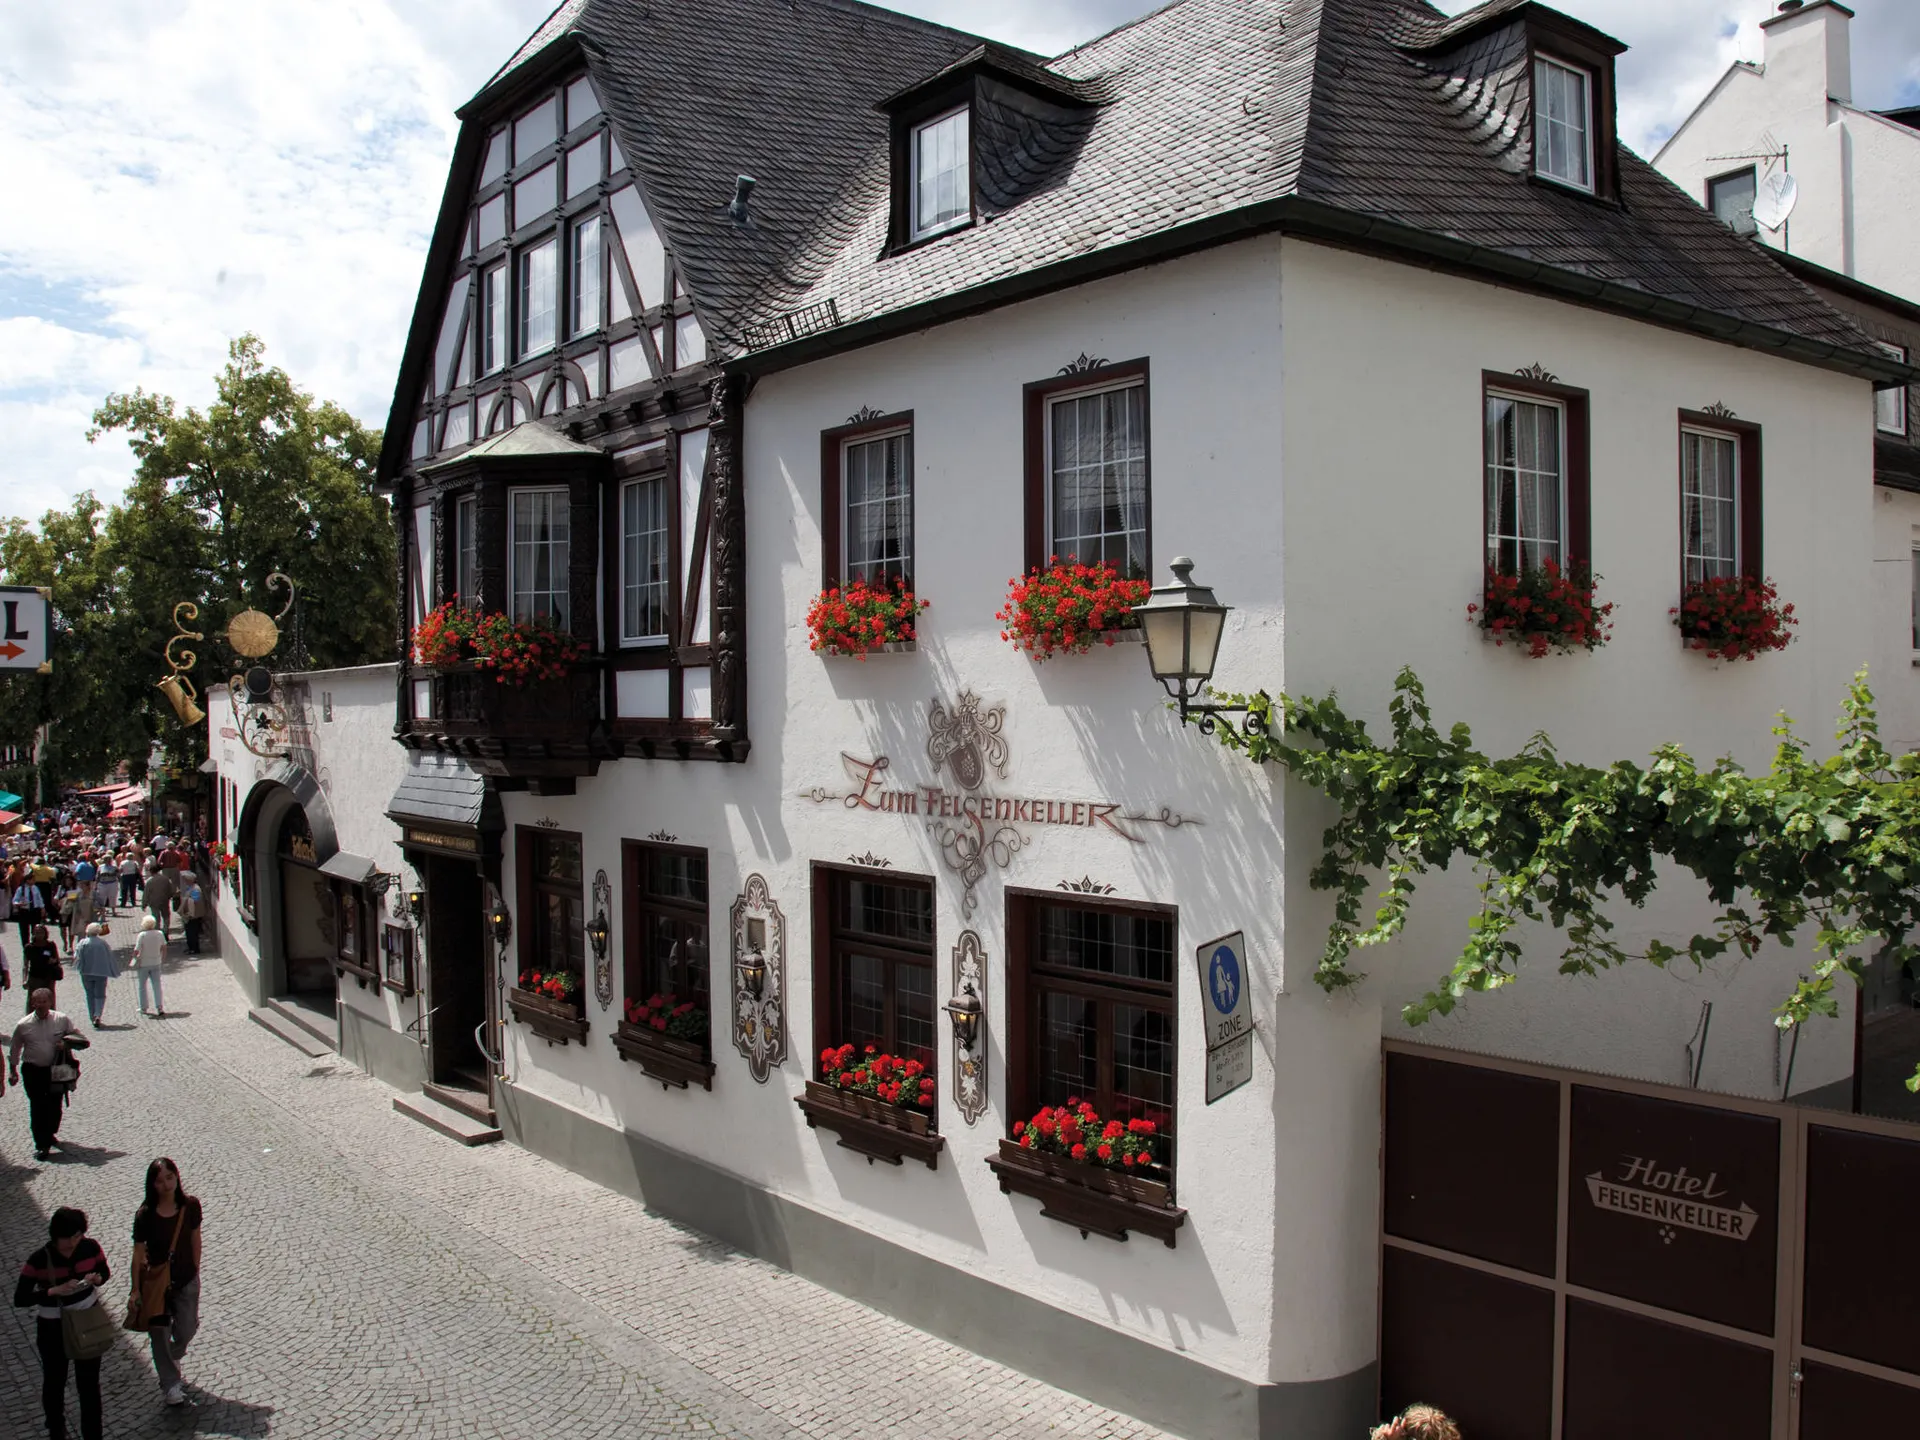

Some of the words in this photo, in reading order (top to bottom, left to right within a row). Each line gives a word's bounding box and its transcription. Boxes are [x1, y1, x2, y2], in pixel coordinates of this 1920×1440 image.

[841, 751, 917, 814] Zum
[1218, 1014, 1242, 1042] ZONE
[1618, 1153, 1728, 1199] Hotel
[1598, 1186, 1744, 1236] FELSENKELLER
